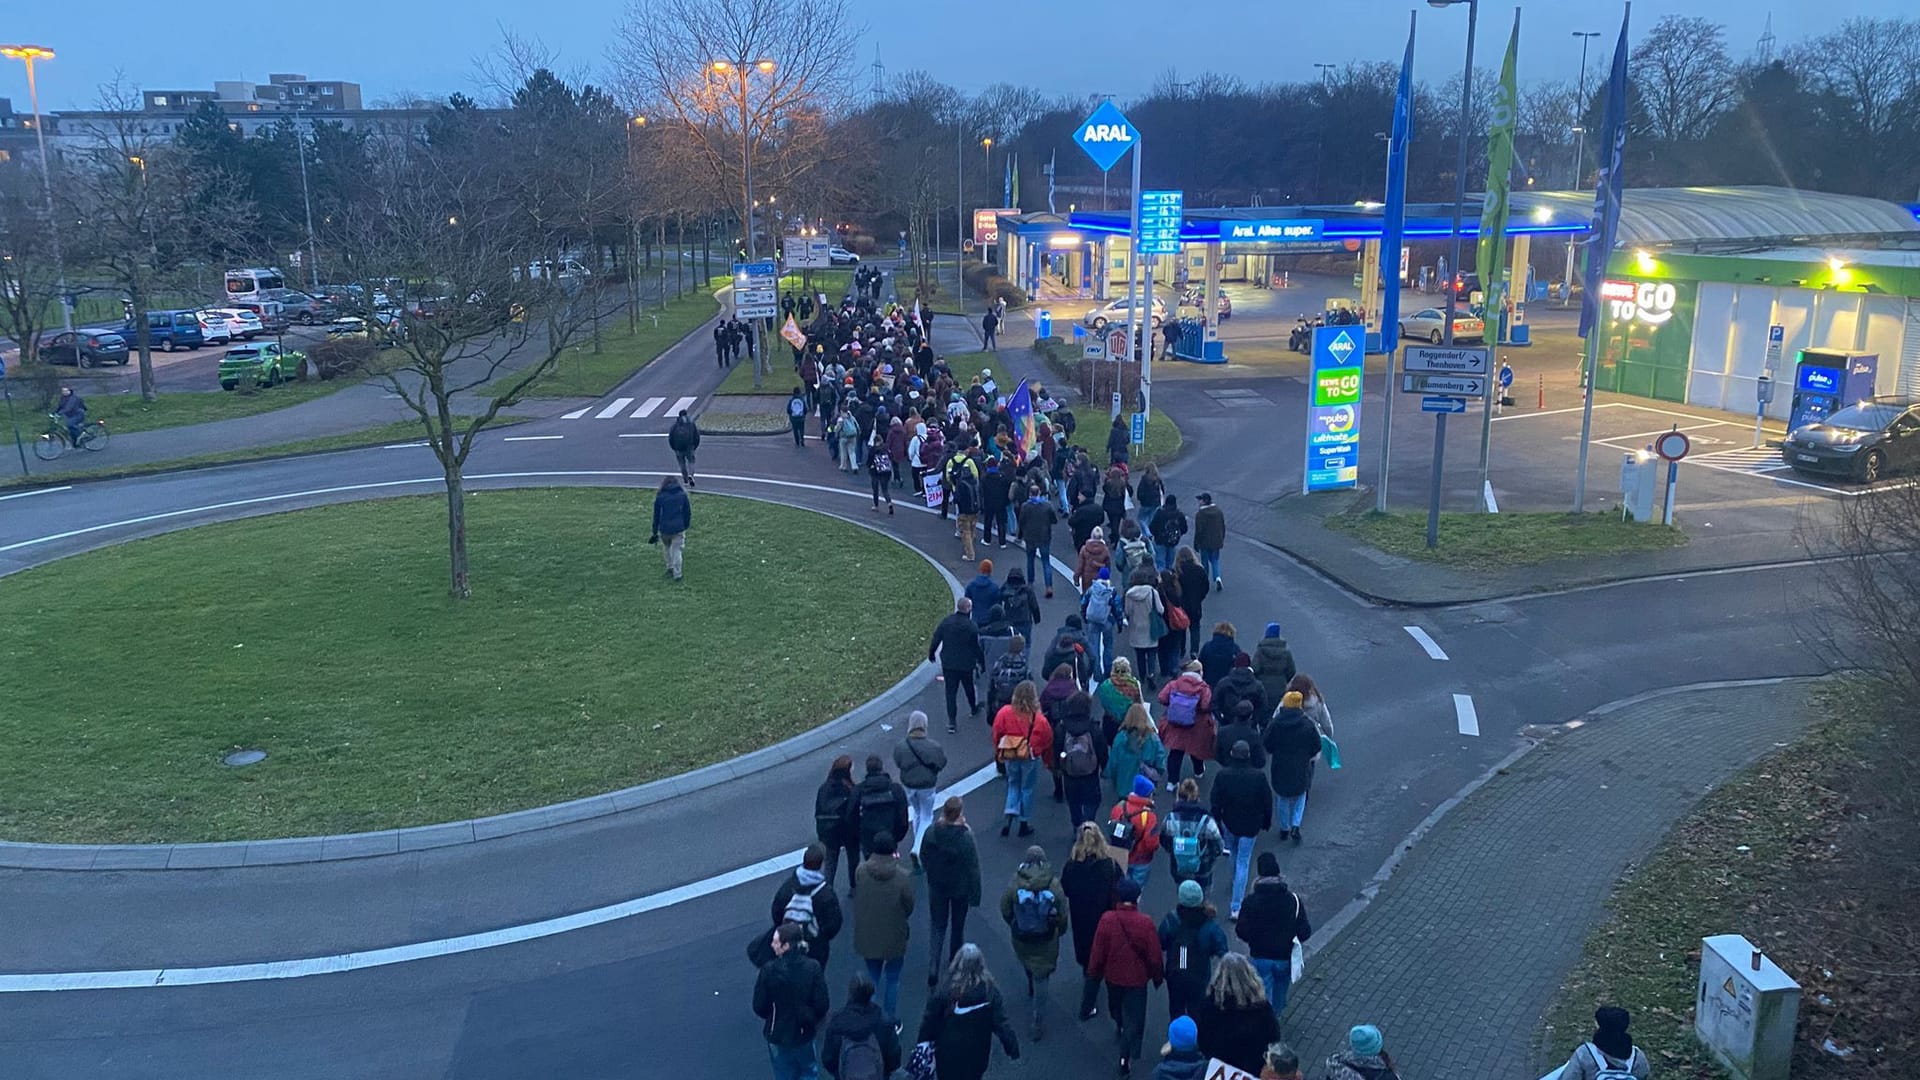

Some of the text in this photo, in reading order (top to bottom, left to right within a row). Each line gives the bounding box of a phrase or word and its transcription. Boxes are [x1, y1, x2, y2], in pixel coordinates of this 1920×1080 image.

[1083, 124, 1132, 142] ARAL
[1232, 225, 1314, 238] Aral. Alles super.
[1637, 282, 1676, 310] GO
[1611, 299, 1635, 320] TO
[1332, 342, 1353, 351] ARAL
[1419, 350, 1466, 360] Roggendorf/
[1426, 360, 1466, 369] Thenhoven
[1340, 374, 1359, 389] GO
[1326, 387, 1340, 398] TO
[1326, 413, 1348, 425] pulse
[1313, 432, 1349, 444] ultimate
